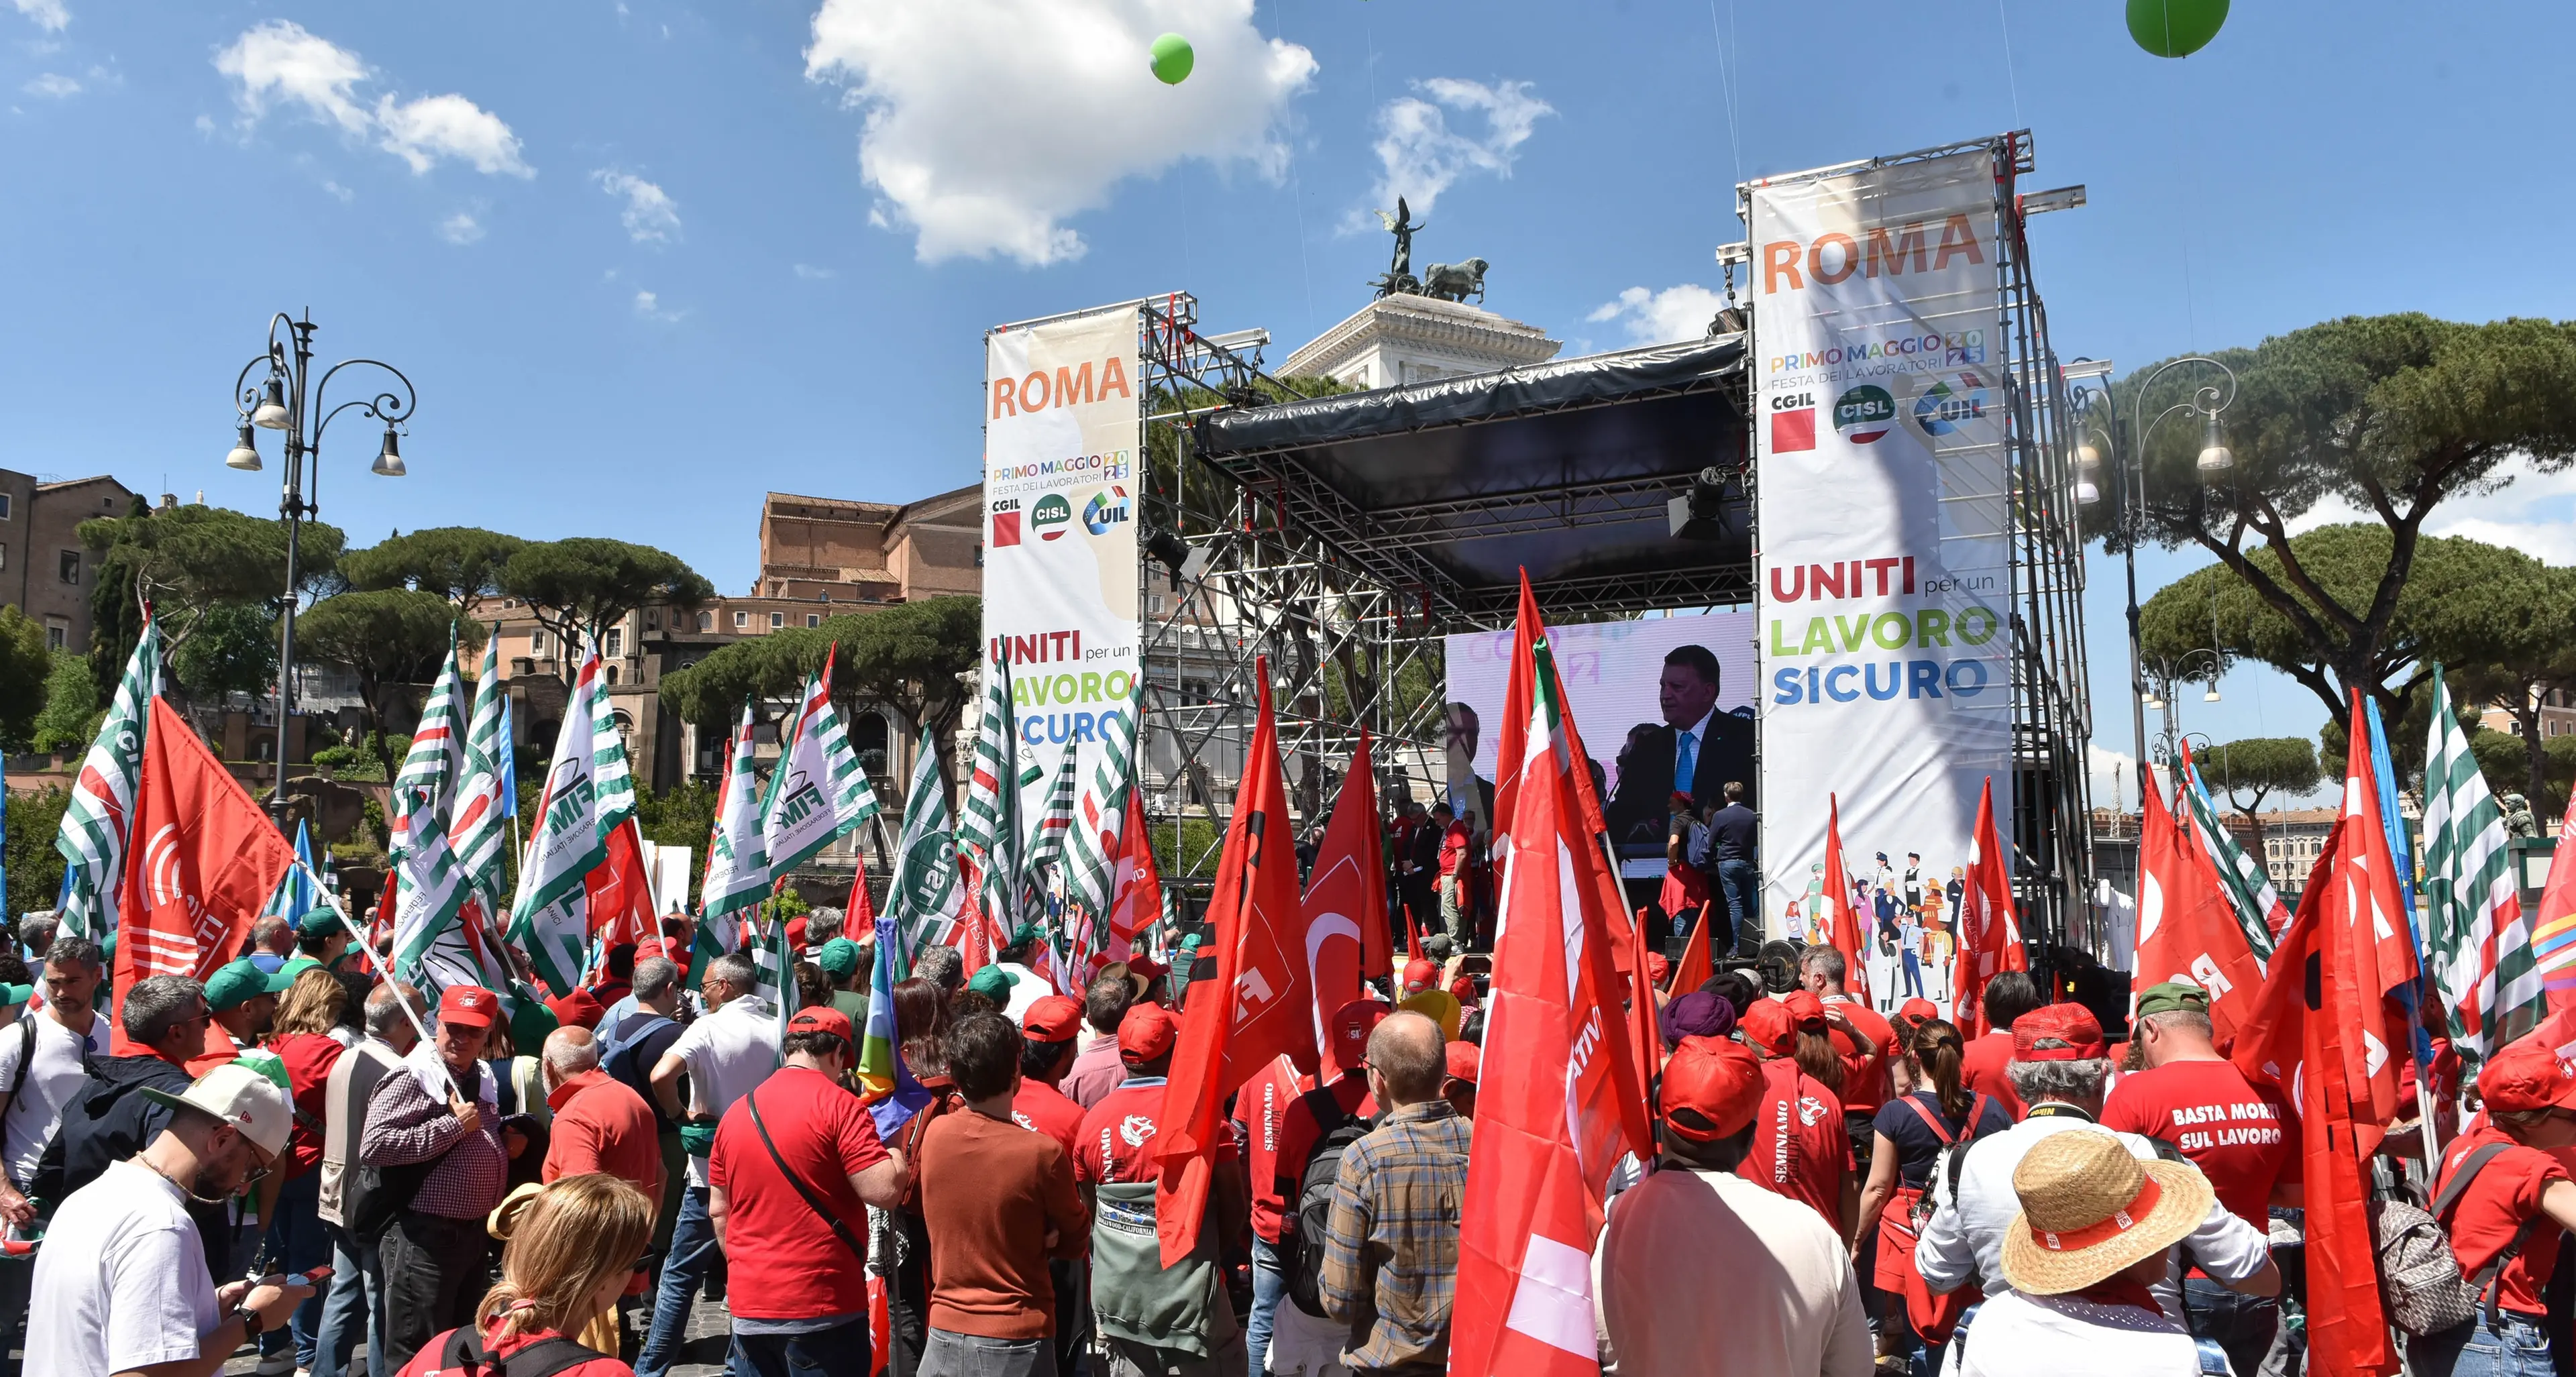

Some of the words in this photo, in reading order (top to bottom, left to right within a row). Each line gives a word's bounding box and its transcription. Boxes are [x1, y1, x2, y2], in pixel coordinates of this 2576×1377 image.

[1764, 213, 1984, 294] ROMA
[1771, 348, 1842, 373] PRIMO
[1847, 335, 1941, 362] MAGGIO
[992, 357, 1130, 420] ROMA
[1772, 376, 1815, 390] FESTA
[1819, 371, 1842, 384] DEI
[1846, 357, 1941, 380] LAVORATORI
[1772, 392, 1815, 409] CGIL
[1841, 399, 1889, 418] CISL
[1940, 398, 1986, 422] UIL
[994, 463, 1038, 482] PRIMO
[1040, 455, 1101, 475] MAGGIO
[993, 485, 1020, 496] FESTA
[1023, 482, 1038, 491] DEI
[1040, 474, 1102, 490] LAVORATORI
[992, 498, 1020, 512] CGIL
[1036, 505, 1067, 520] CISL
[1099, 506, 1128, 523] UIL
[1771, 556, 1915, 603] UNITI
[1925, 578, 1960, 598] per
[1968, 575, 1994, 590] un
[1771, 606, 1997, 657] LAVORO
[991, 630, 1080, 665] UNITI
[1086, 647, 1110, 663] per
[1113, 646, 1130, 657] un
[1012, 669, 1130, 707] AVORO
[1774, 659, 1988, 705] SICURO
[1014, 711, 1120, 746] CURO
[1265, 1083, 1274, 1152] SEMINIAMO
[2172, 1105, 2227, 1126] BASTA
[2231, 1103, 2281, 1119] MORTI
[1775, 1100, 1789, 1183] SEMINIAMO
[2180, 1131, 2214, 1149] SUL
[2217, 1128, 2282, 1146] LAVORO
[2120, 1218, 2131, 1227] SPI
[2049, 1240, 2058, 1248] SPI
